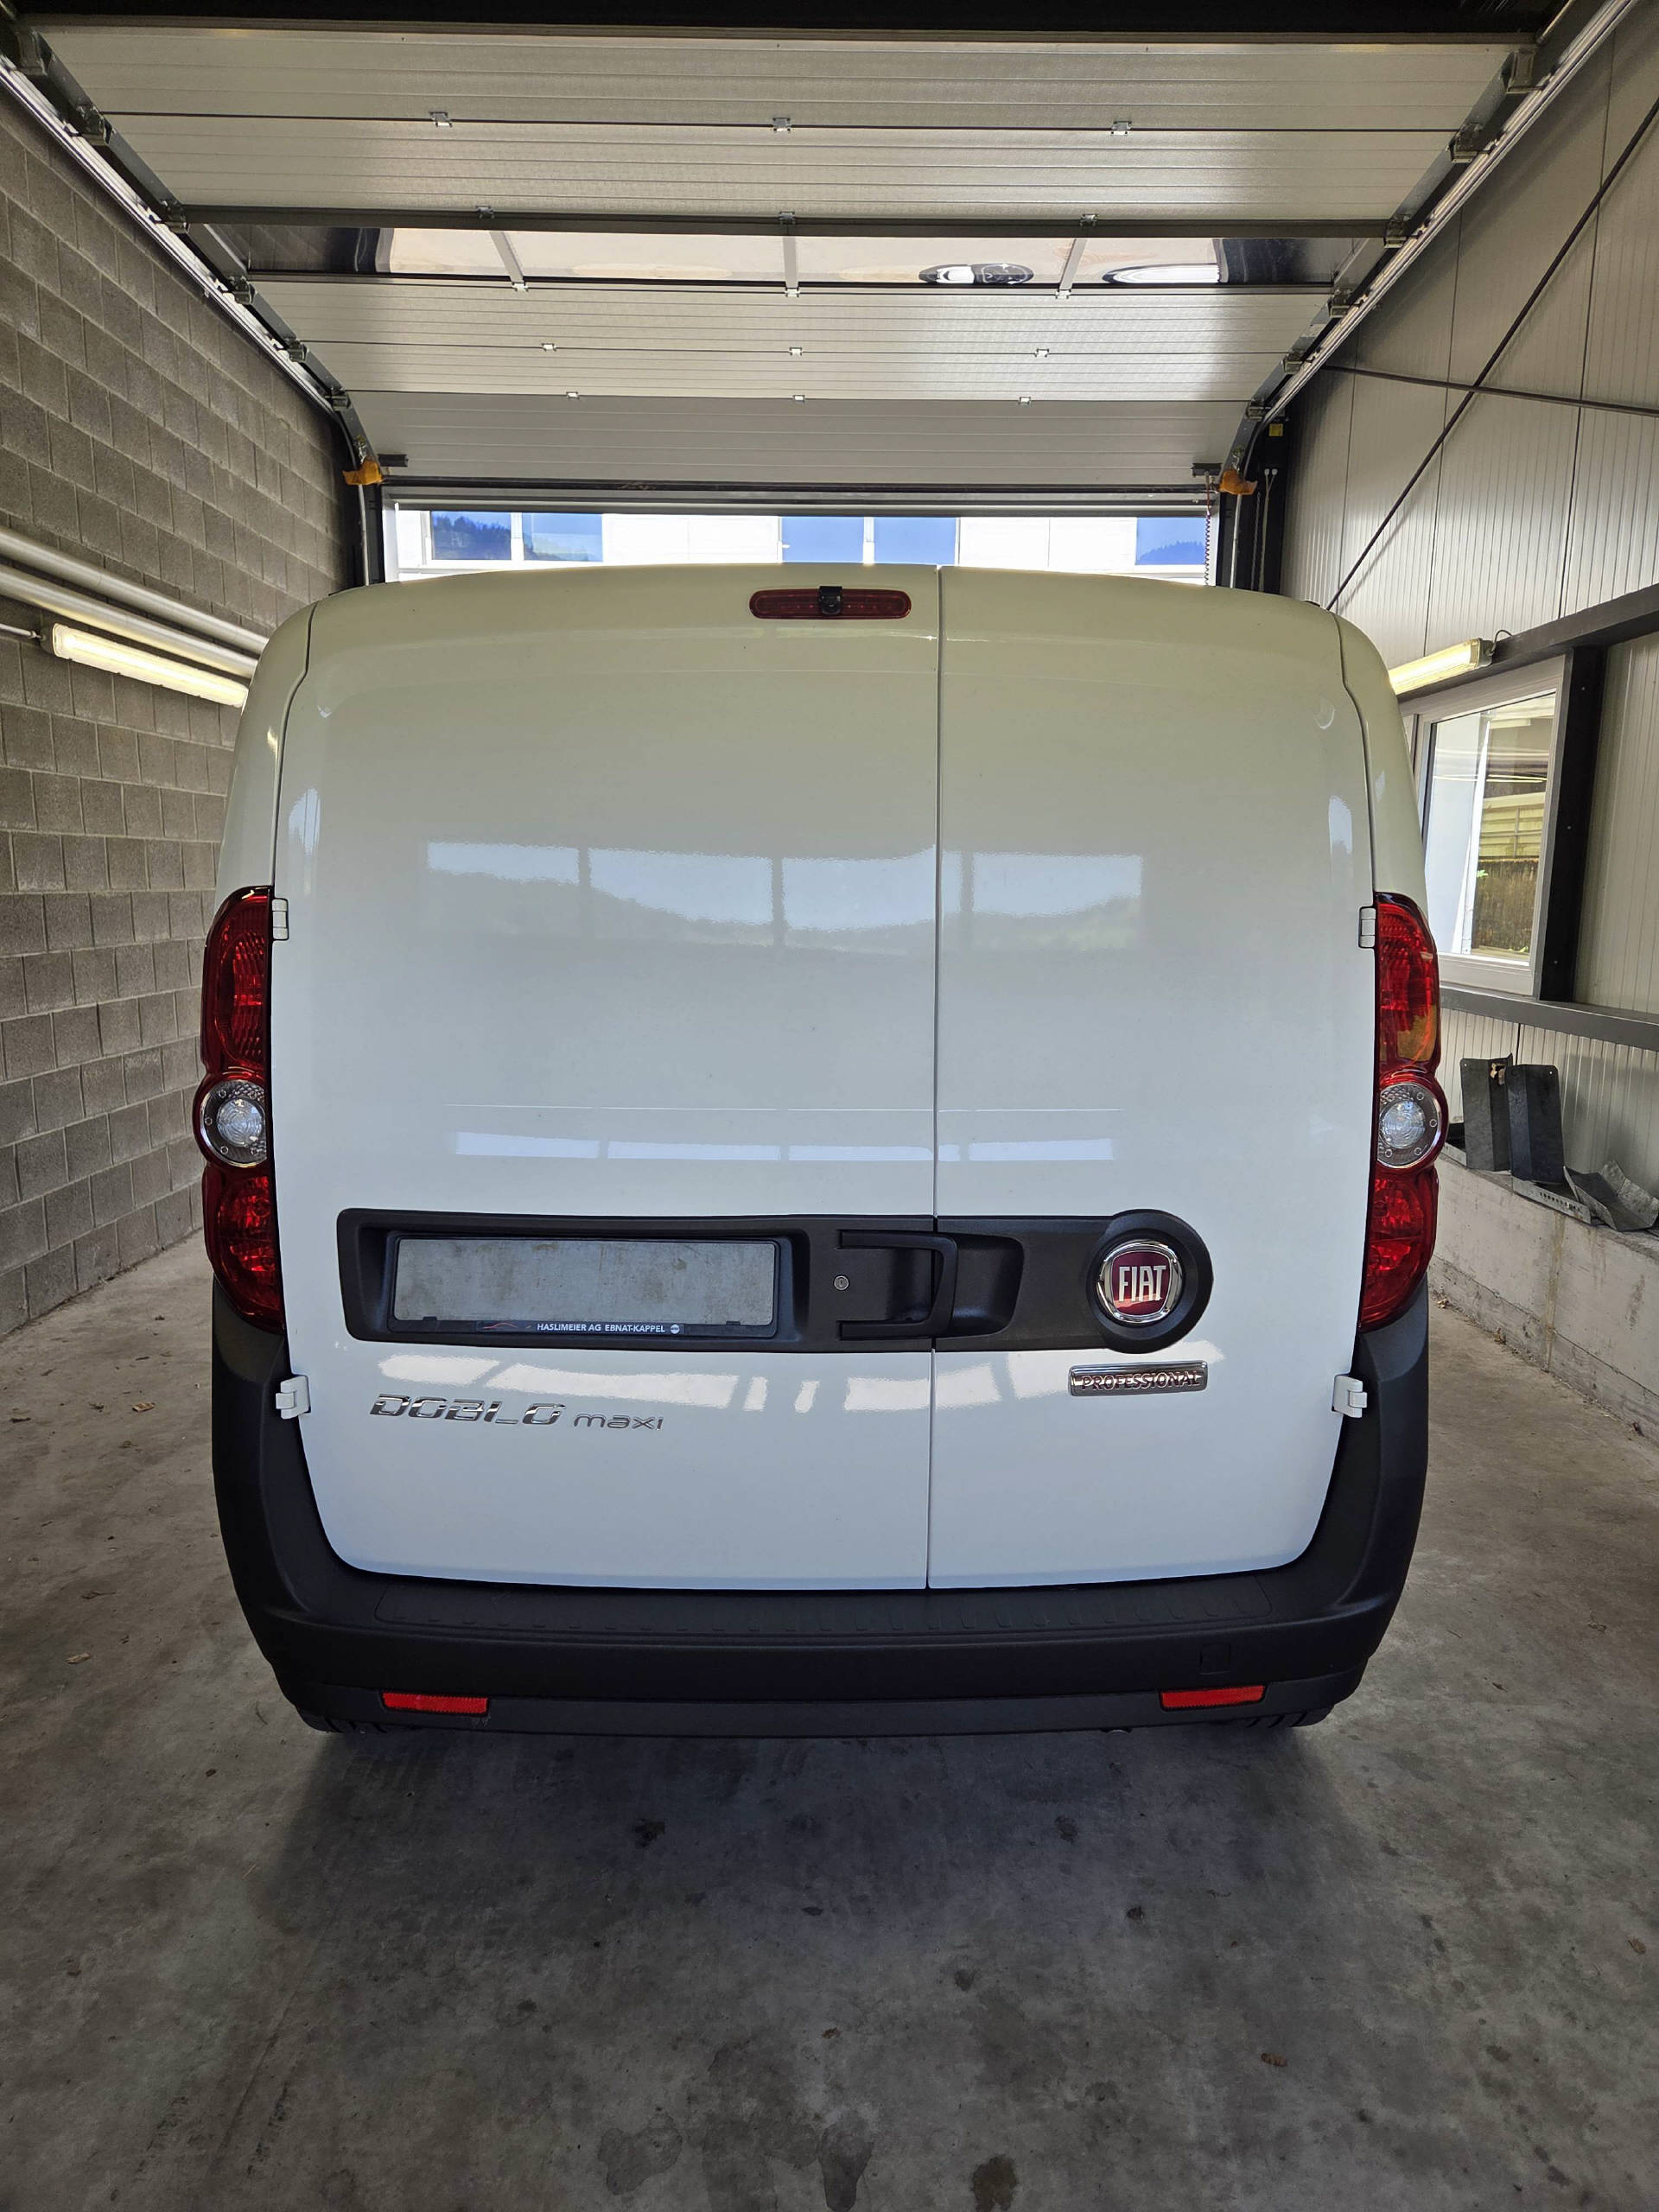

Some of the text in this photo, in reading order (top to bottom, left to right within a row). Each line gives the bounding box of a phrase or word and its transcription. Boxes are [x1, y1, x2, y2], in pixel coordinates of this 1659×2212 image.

[1119, 1265, 1166, 1302] FIAT
[537, 1323, 586, 1332] HASLIMEIER
[605, 1324, 665, 1332] EBNAT-KAPPEL
[1080, 1370, 1202, 1391] PROFESSIONAL
[574, 1413, 664, 1431] maxi
